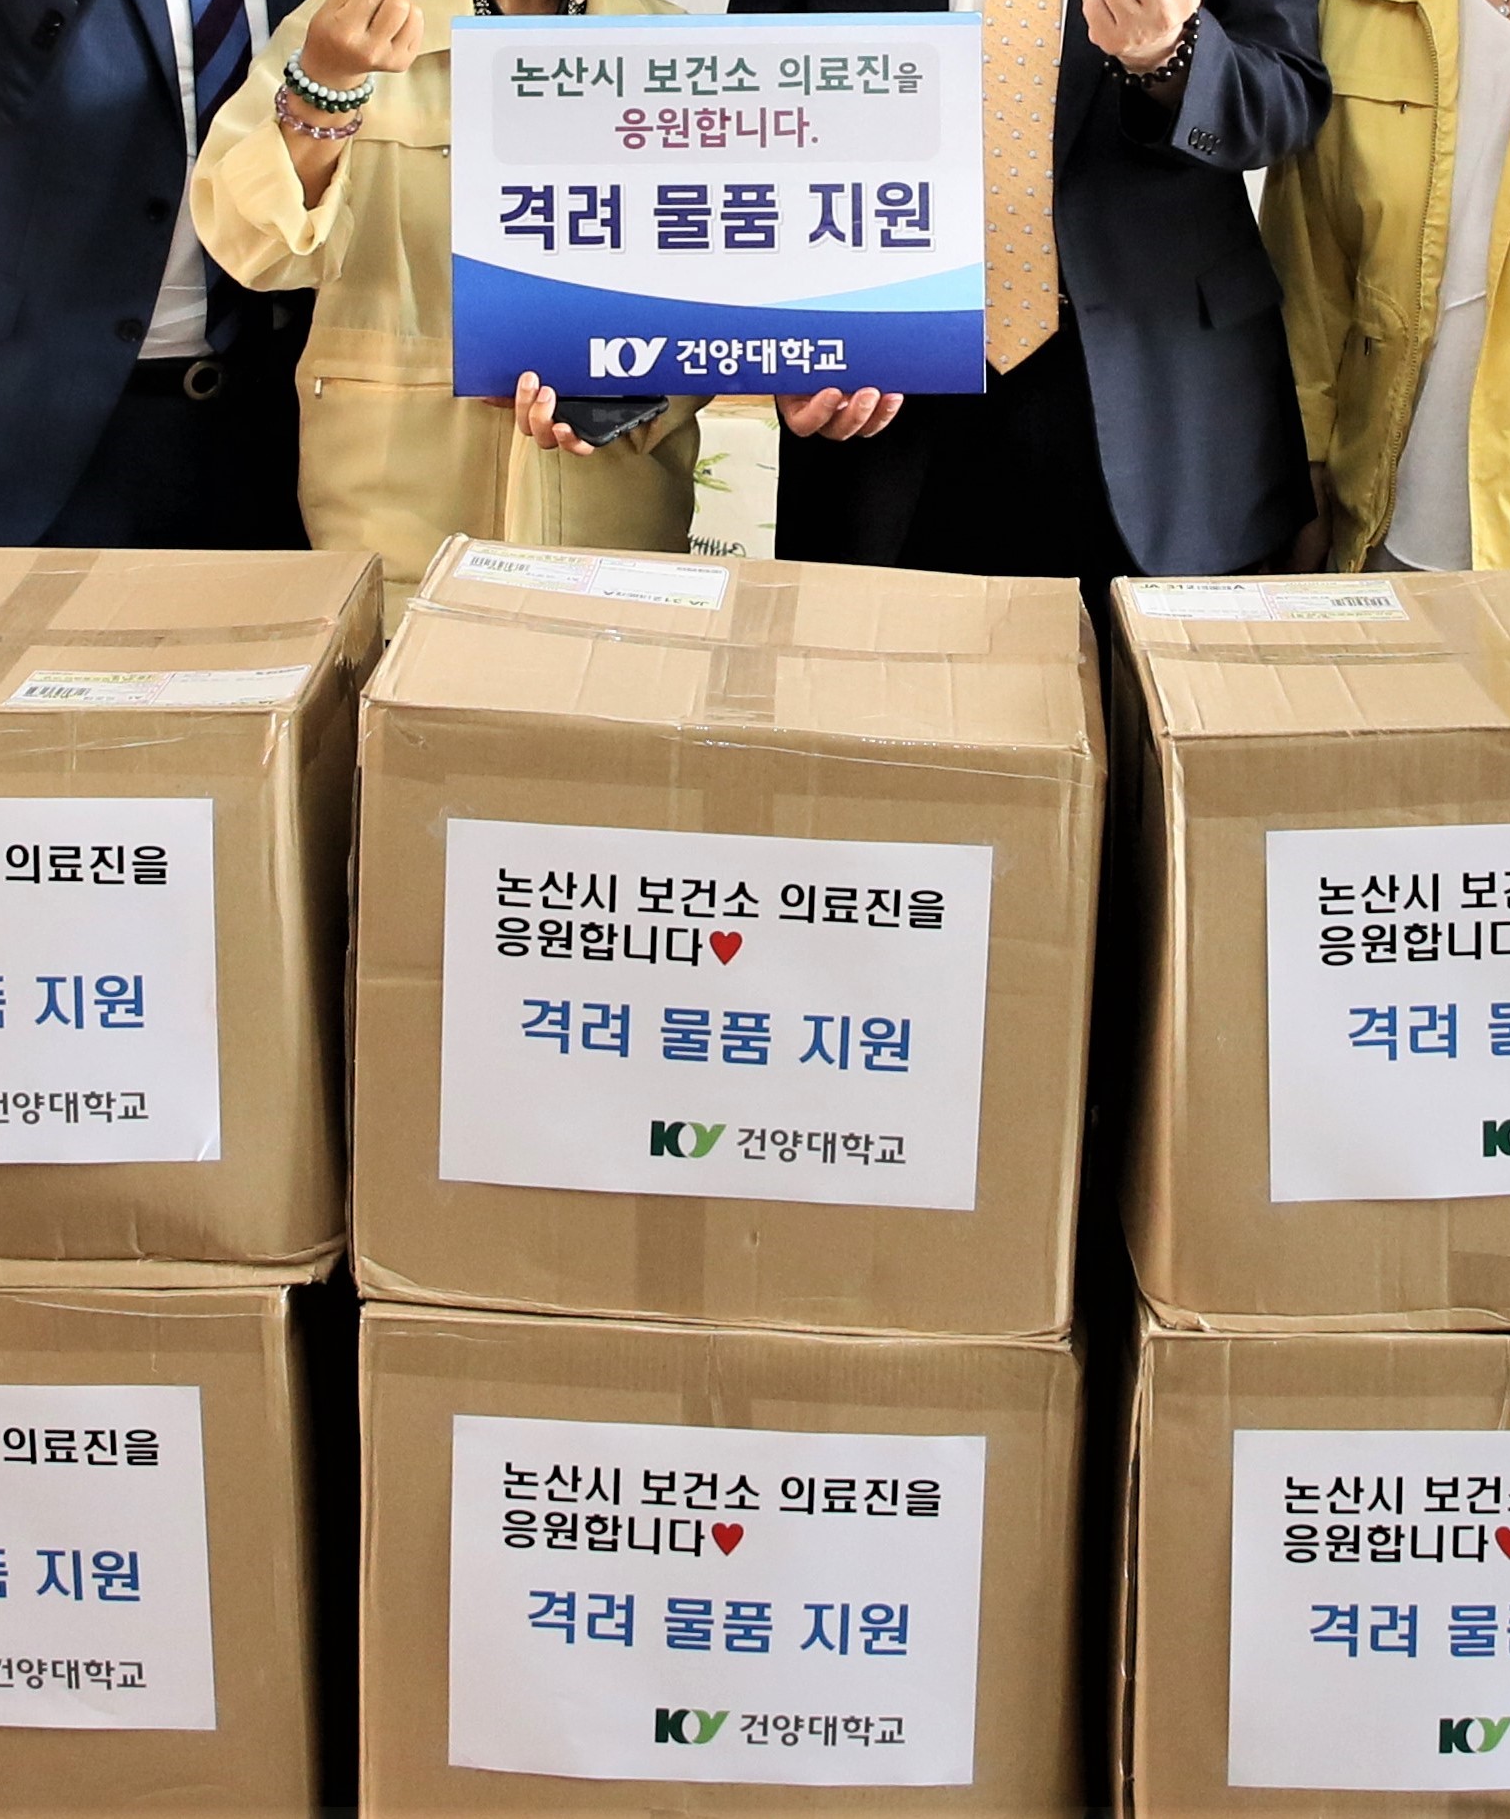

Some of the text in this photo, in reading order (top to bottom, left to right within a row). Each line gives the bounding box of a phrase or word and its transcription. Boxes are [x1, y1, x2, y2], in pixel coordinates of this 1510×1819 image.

[511, 55, 922, 97] 논산시 보건소 의료진을
[615, 107, 819, 150] 응원합니다.
[500, 182, 930, 250] 격려 물품 지원
[677, 339, 846, 375] 건양대학교
[6, 845, 168, 884] 의료진을
[497, 868, 944, 929] 논산시 보건소 의료진을
[1319, 873, 1438, 915] 논산시
[496, 917, 703, 966] 응원합니다
[35, 975, 144, 1029] 지원
[522, 999, 910, 1072] 격려 물품 지원
[1349, 1003, 1457, 1061] 격려
[737, 1129, 906, 1165] 건양대학교
[3, 1428, 159, 1466] 의료진을
[504, 1462, 941, 1517] 논산시 보건소 의료진을
[1285, 1477, 1403, 1515] 논산시
[503, 1510, 705, 1557] 응원합니다
[1284, 1524, 1488, 1563] 응원합니다
[37, 1550, 140, 1601] 지원
[528, 1591, 908, 1655] 격려 물품 지원
[1310, 1604, 1417, 1658] 격려
[740, 1715, 905, 1747] 건양대학교
